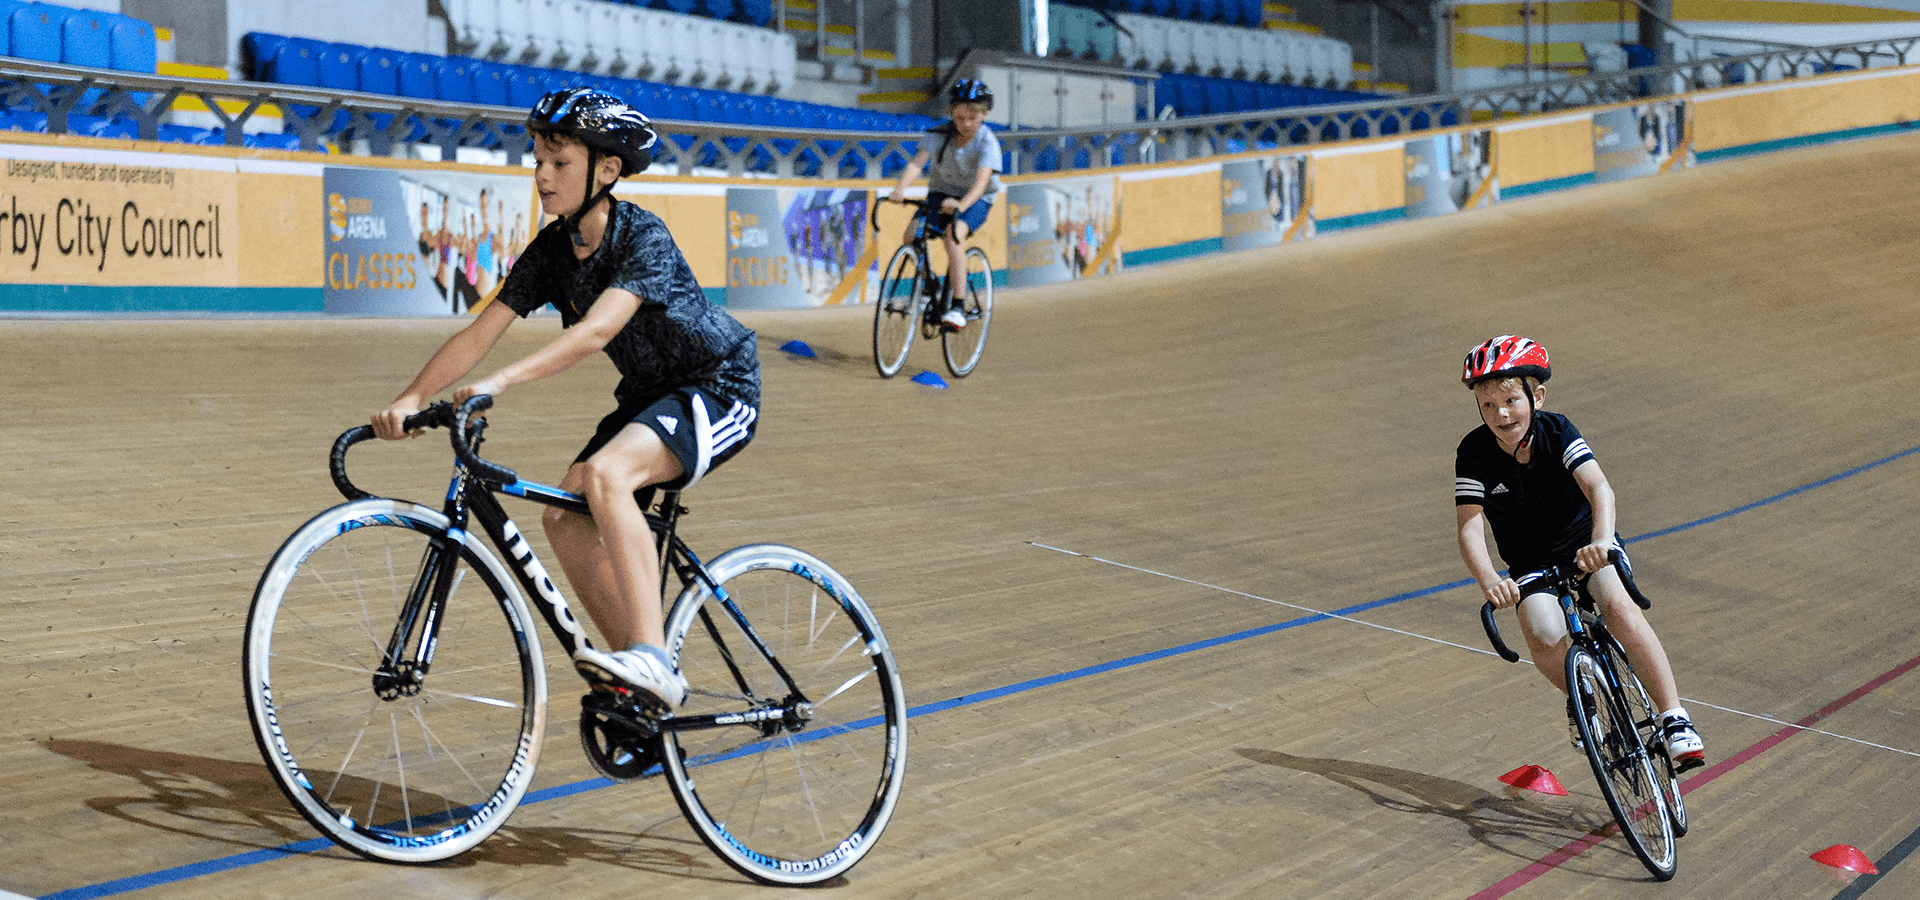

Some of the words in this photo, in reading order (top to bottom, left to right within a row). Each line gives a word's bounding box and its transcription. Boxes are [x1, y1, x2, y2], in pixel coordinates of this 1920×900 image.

[62, 161, 96, 181] funded
[98, 165, 117, 181] and
[119, 167, 162, 188] operated
[163, 167, 176, 190] by
[56, 198, 112, 272] City
[121, 201, 223, 259] Council
[347, 215, 387, 239] ARENA
[329, 252, 417, 290] CLASSES
[729, 256, 788, 287] CYCLING
